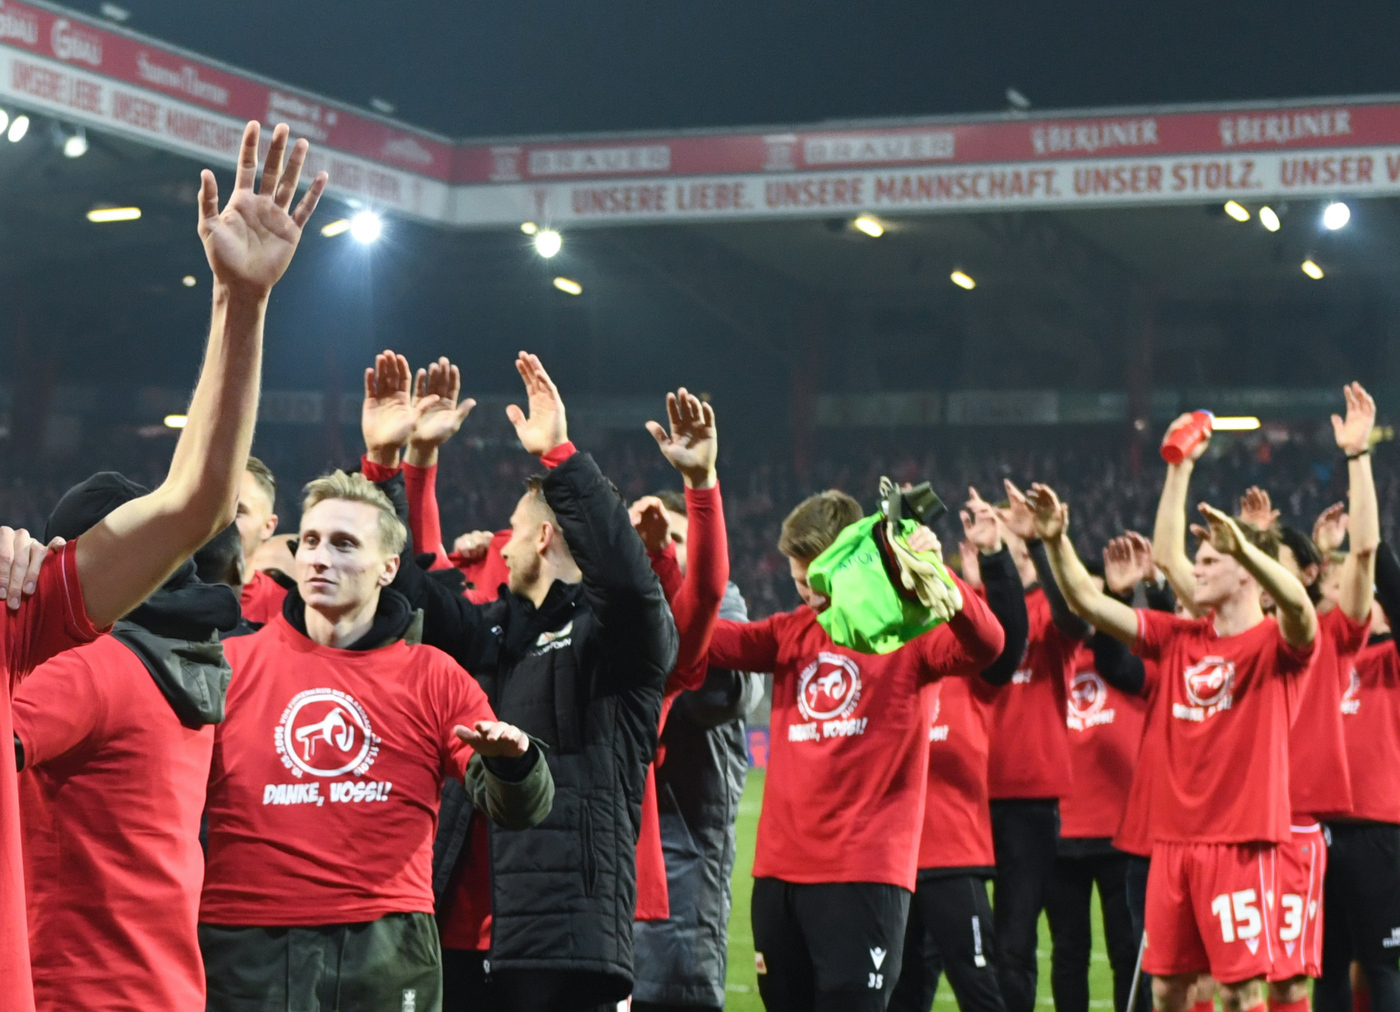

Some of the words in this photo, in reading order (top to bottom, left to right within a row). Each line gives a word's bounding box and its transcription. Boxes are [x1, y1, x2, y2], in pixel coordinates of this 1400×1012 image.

[571, 184, 667, 215] UNSERE
[763, 176, 864, 209] UNSERE
[874, 169, 1061, 204] MANNSCHAFT.
[1074, 164, 1163, 196] UNSER
[1172, 159, 1264, 192] STOLZ.
[1281, 154, 1375, 188] UNSER
[262, 781, 325, 807] DANKE,
[329, 780, 393, 803] VOSSI!
[1211, 888, 1263, 943] 15
